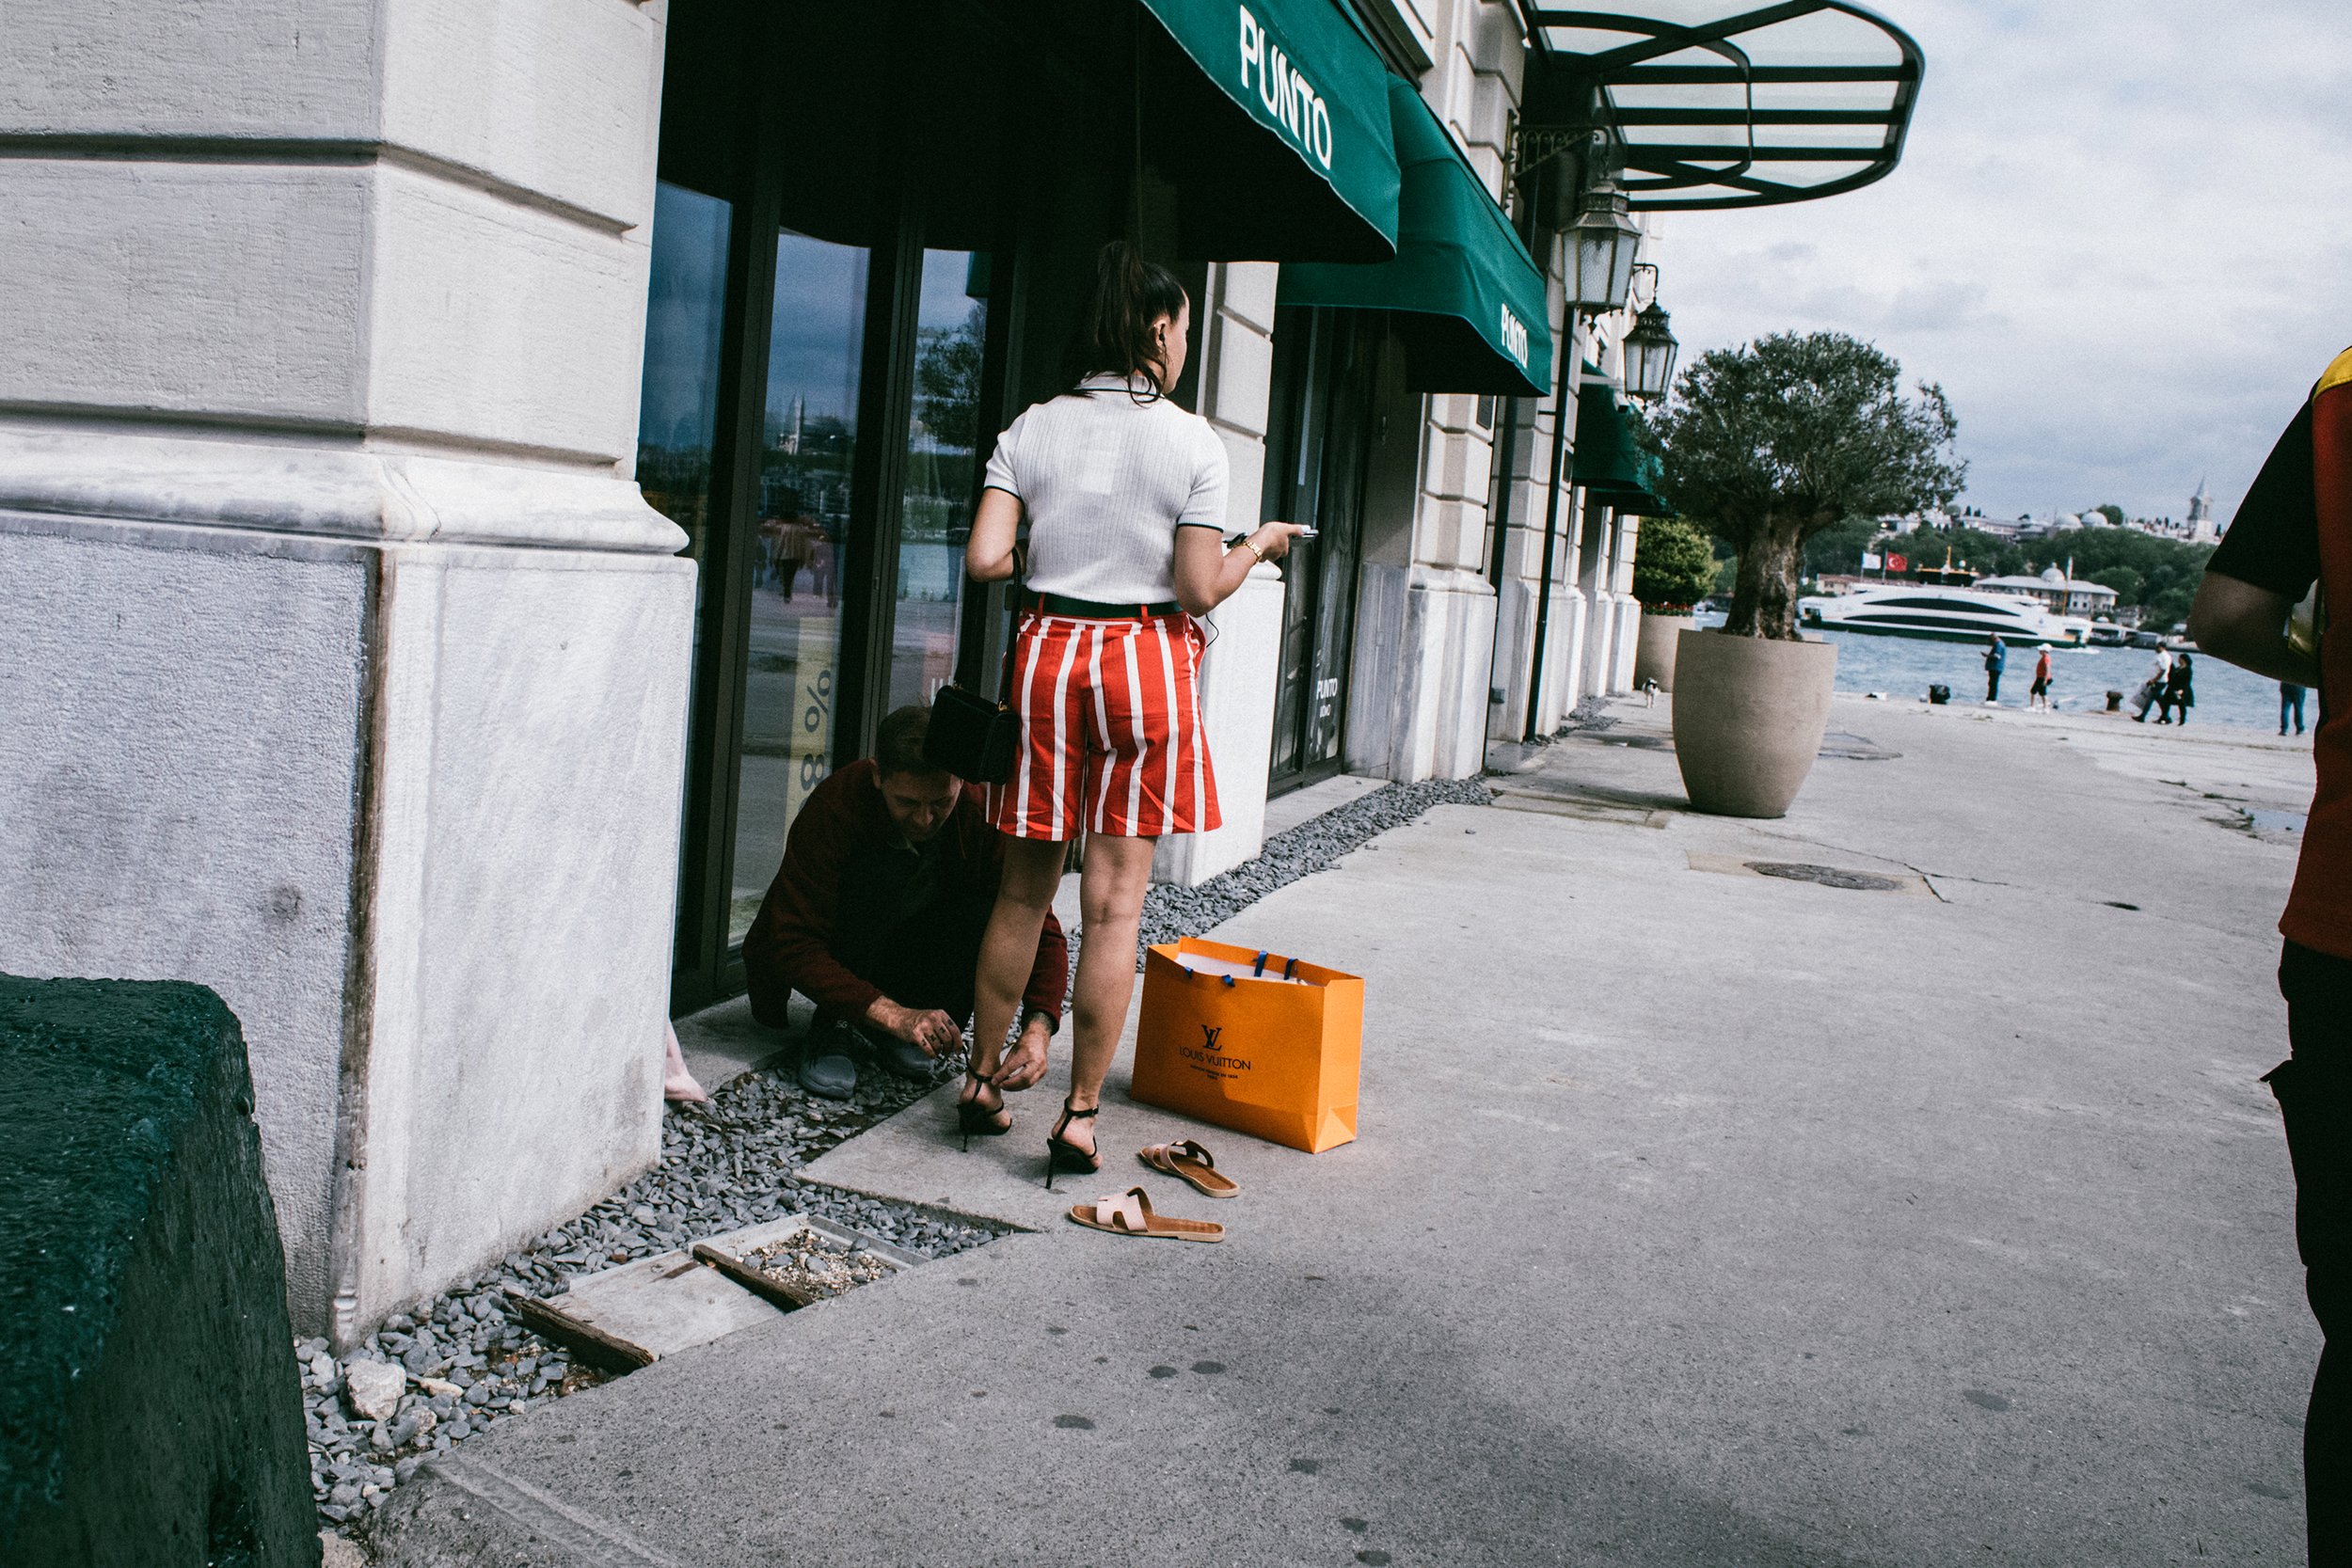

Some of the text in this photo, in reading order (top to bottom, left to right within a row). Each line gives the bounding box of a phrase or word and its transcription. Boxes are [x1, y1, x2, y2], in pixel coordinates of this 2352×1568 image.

[1240, 4, 1332, 170] PUNTO
[1502, 303, 1528, 369] PUNTO
[1316, 677, 1338, 700] PUNTO
[1179, 1046, 1204, 1062] LOUIS
[1205, 1053, 1251, 1070] VUITTON
